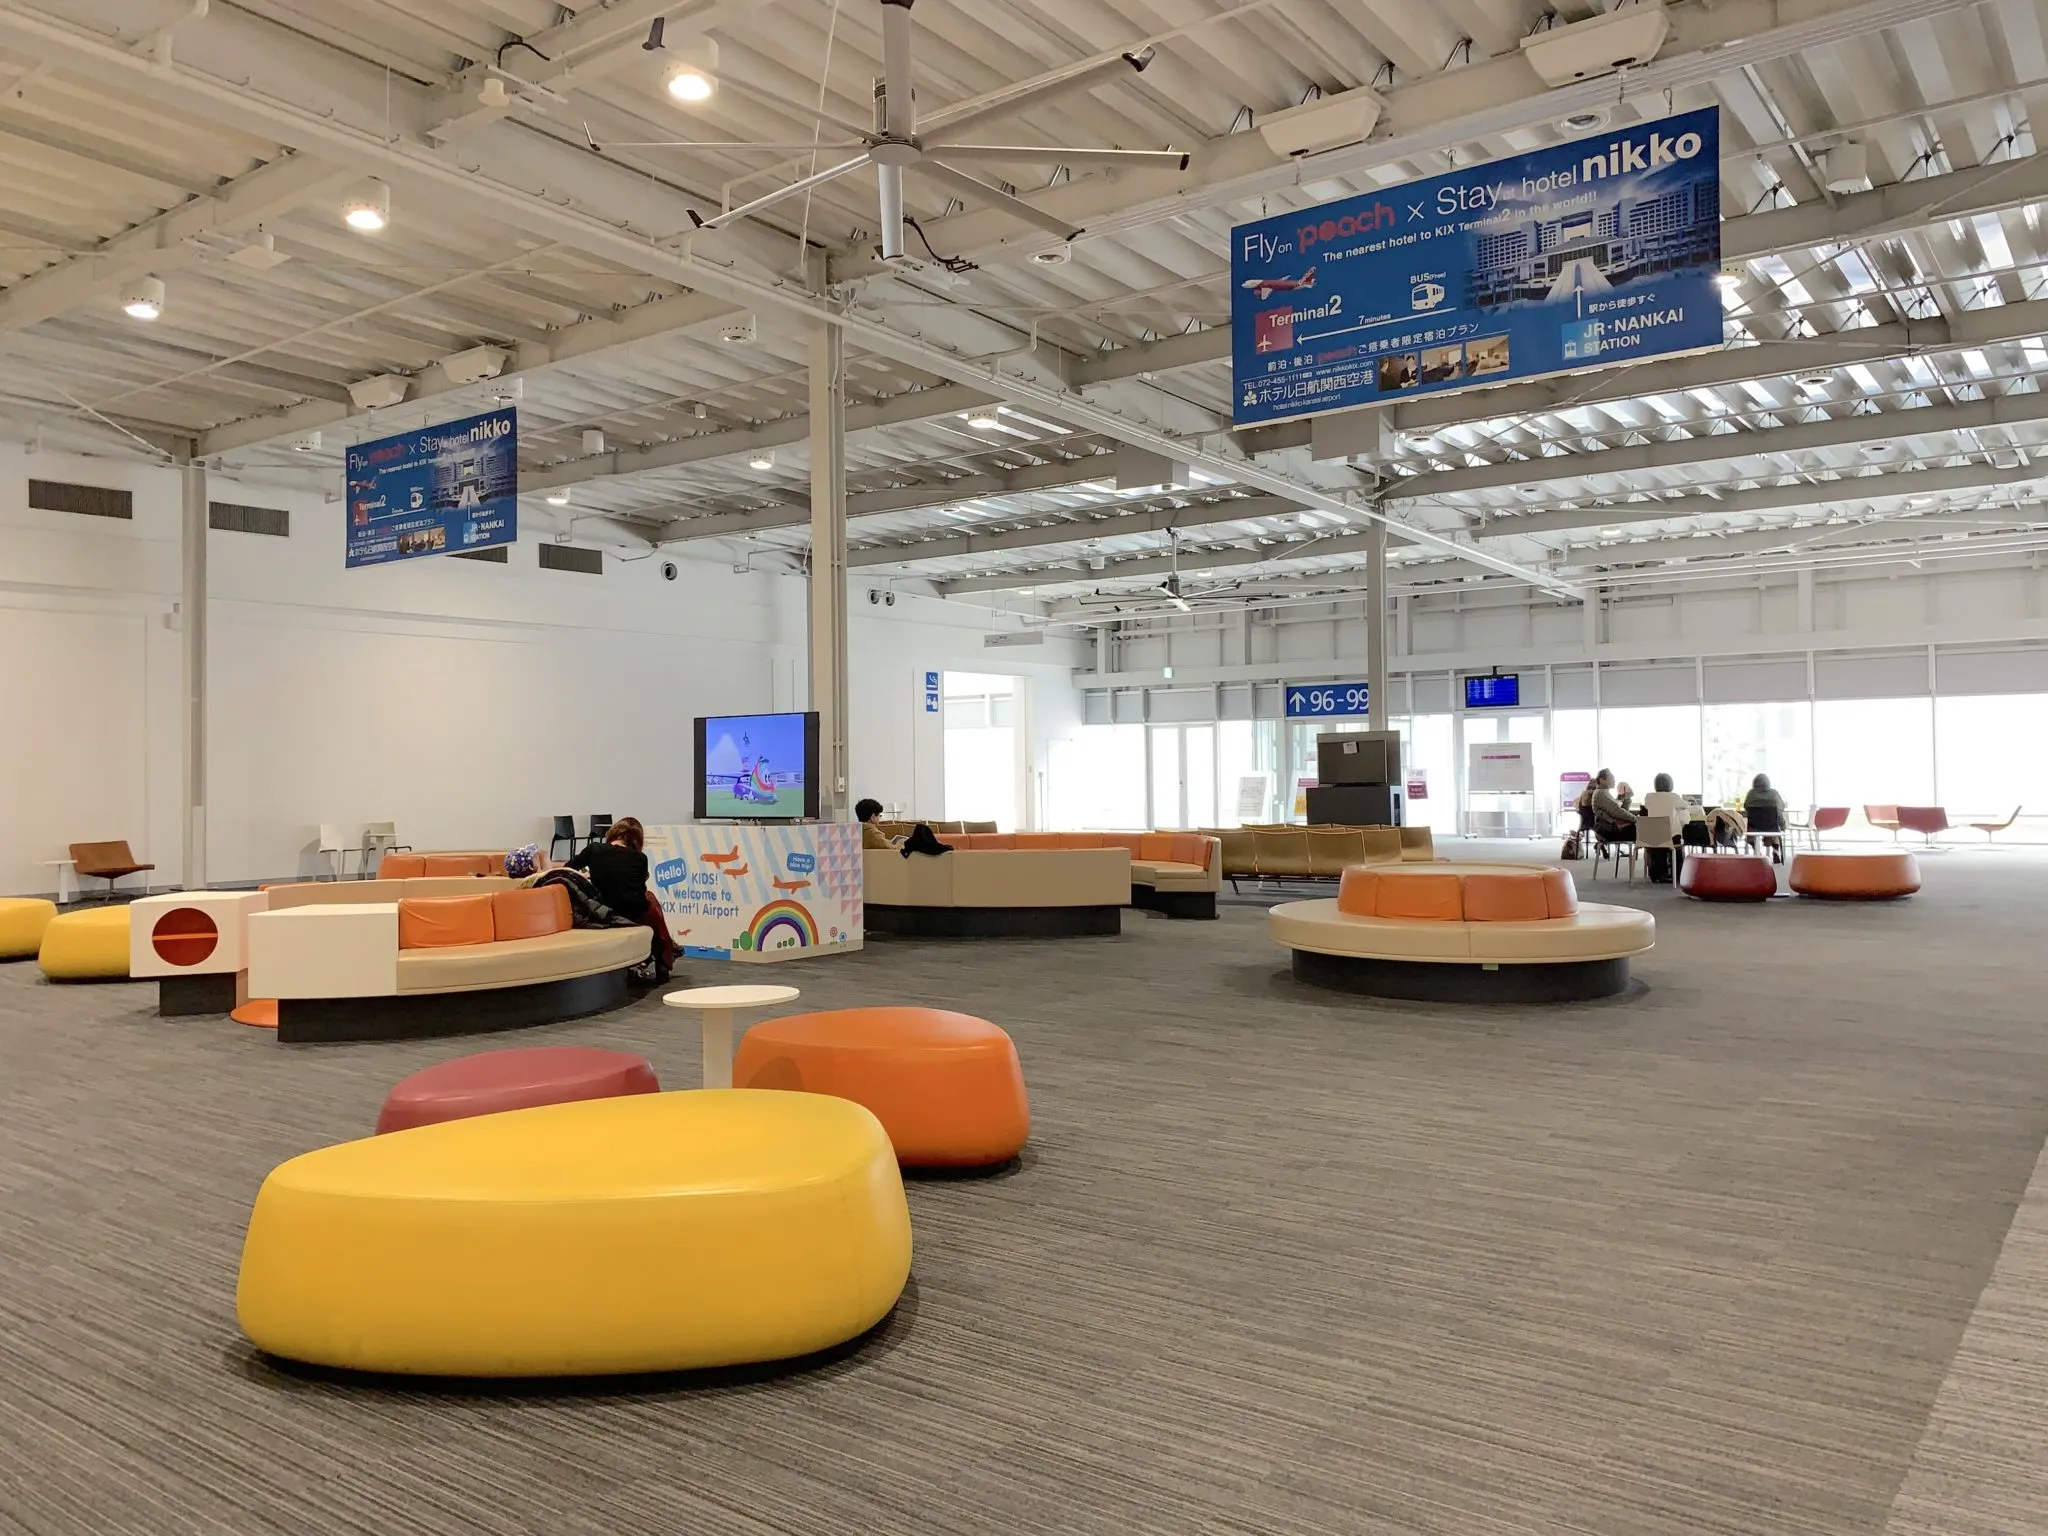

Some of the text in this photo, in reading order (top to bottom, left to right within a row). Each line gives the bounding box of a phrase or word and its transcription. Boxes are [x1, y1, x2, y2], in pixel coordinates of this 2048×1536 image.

[1244, 232, 1279, 263] Fly
[1278, 242, 1292, 254] on
[1436, 181, 1503, 216] Stay
[1522, 165, 1577, 197] hotel
[1582, 132, 1702, 183] nikko
[1322, 251, 1343, 263] The
[1345, 240, 1386, 257] nearest
[1389, 233, 1417, 248] hotel
[1420, 230, 1431, 241] to
[1435, 223, 1454, 237] KIX
[1459, 208, 1510, 232] Terminal2
[1529, 202, 1549, 215] the
[1552, 191, 1597, 210] world!!
[1269, 294, 1342, 328] Terminal2
[1589, 293, 1656, 314] 駅から徒歩すぐ
[1583, 334, 1640, 354] STATION
[1259, 369, 1374, 403] ホテル日航関西空港
[419, 436, 444, 453] Stay
[470, 418, 511, 442] nikko
[1310, 688, 1369, 712] 96-99
[656, 863, 686, 881] Hello!
[691, 872, 718, 885] KIDS!
[673, 886, 732, 901] welcome to
[660, 901, 676, 912] KIX
[702, 903, 739, 919] Airport
